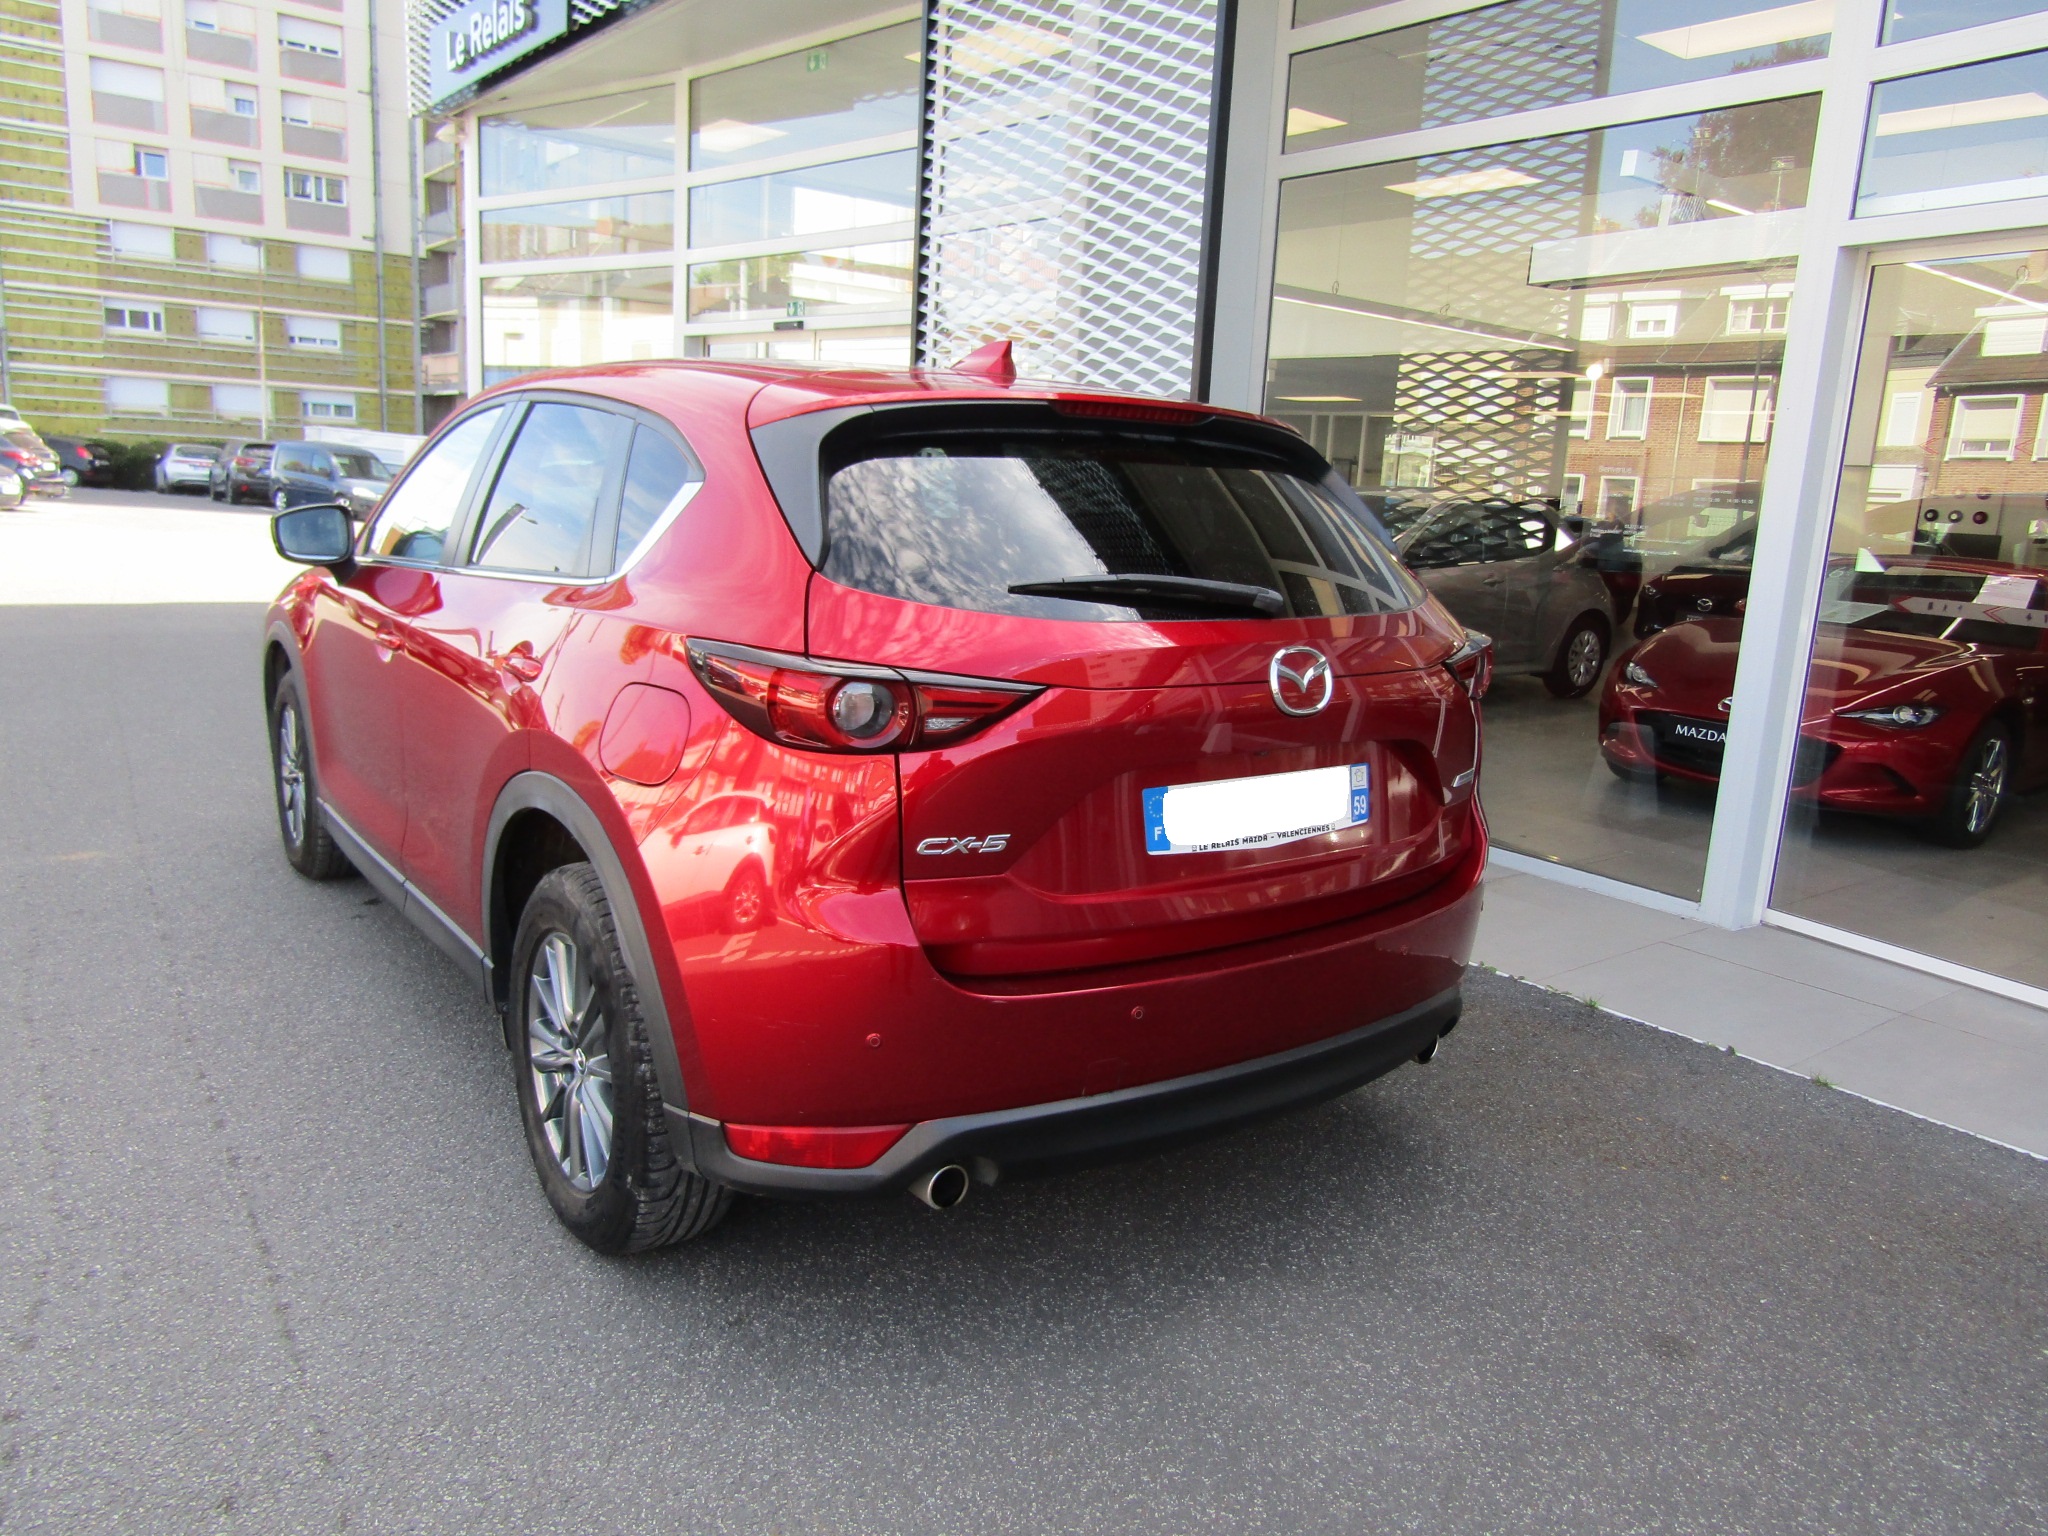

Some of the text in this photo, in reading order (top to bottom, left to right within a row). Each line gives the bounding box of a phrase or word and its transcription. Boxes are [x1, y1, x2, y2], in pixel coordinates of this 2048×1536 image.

[446, 0, 526, 71] Le Relais
[1675, 724, 1727, 743] MAZDA
[1354, 795, 1366, 815] 59
[1154, 826, 1163, 841] F
[1277, 824, 1331, 839] VALENCIENNES
[916, 833, 1012, 855] CX-5
